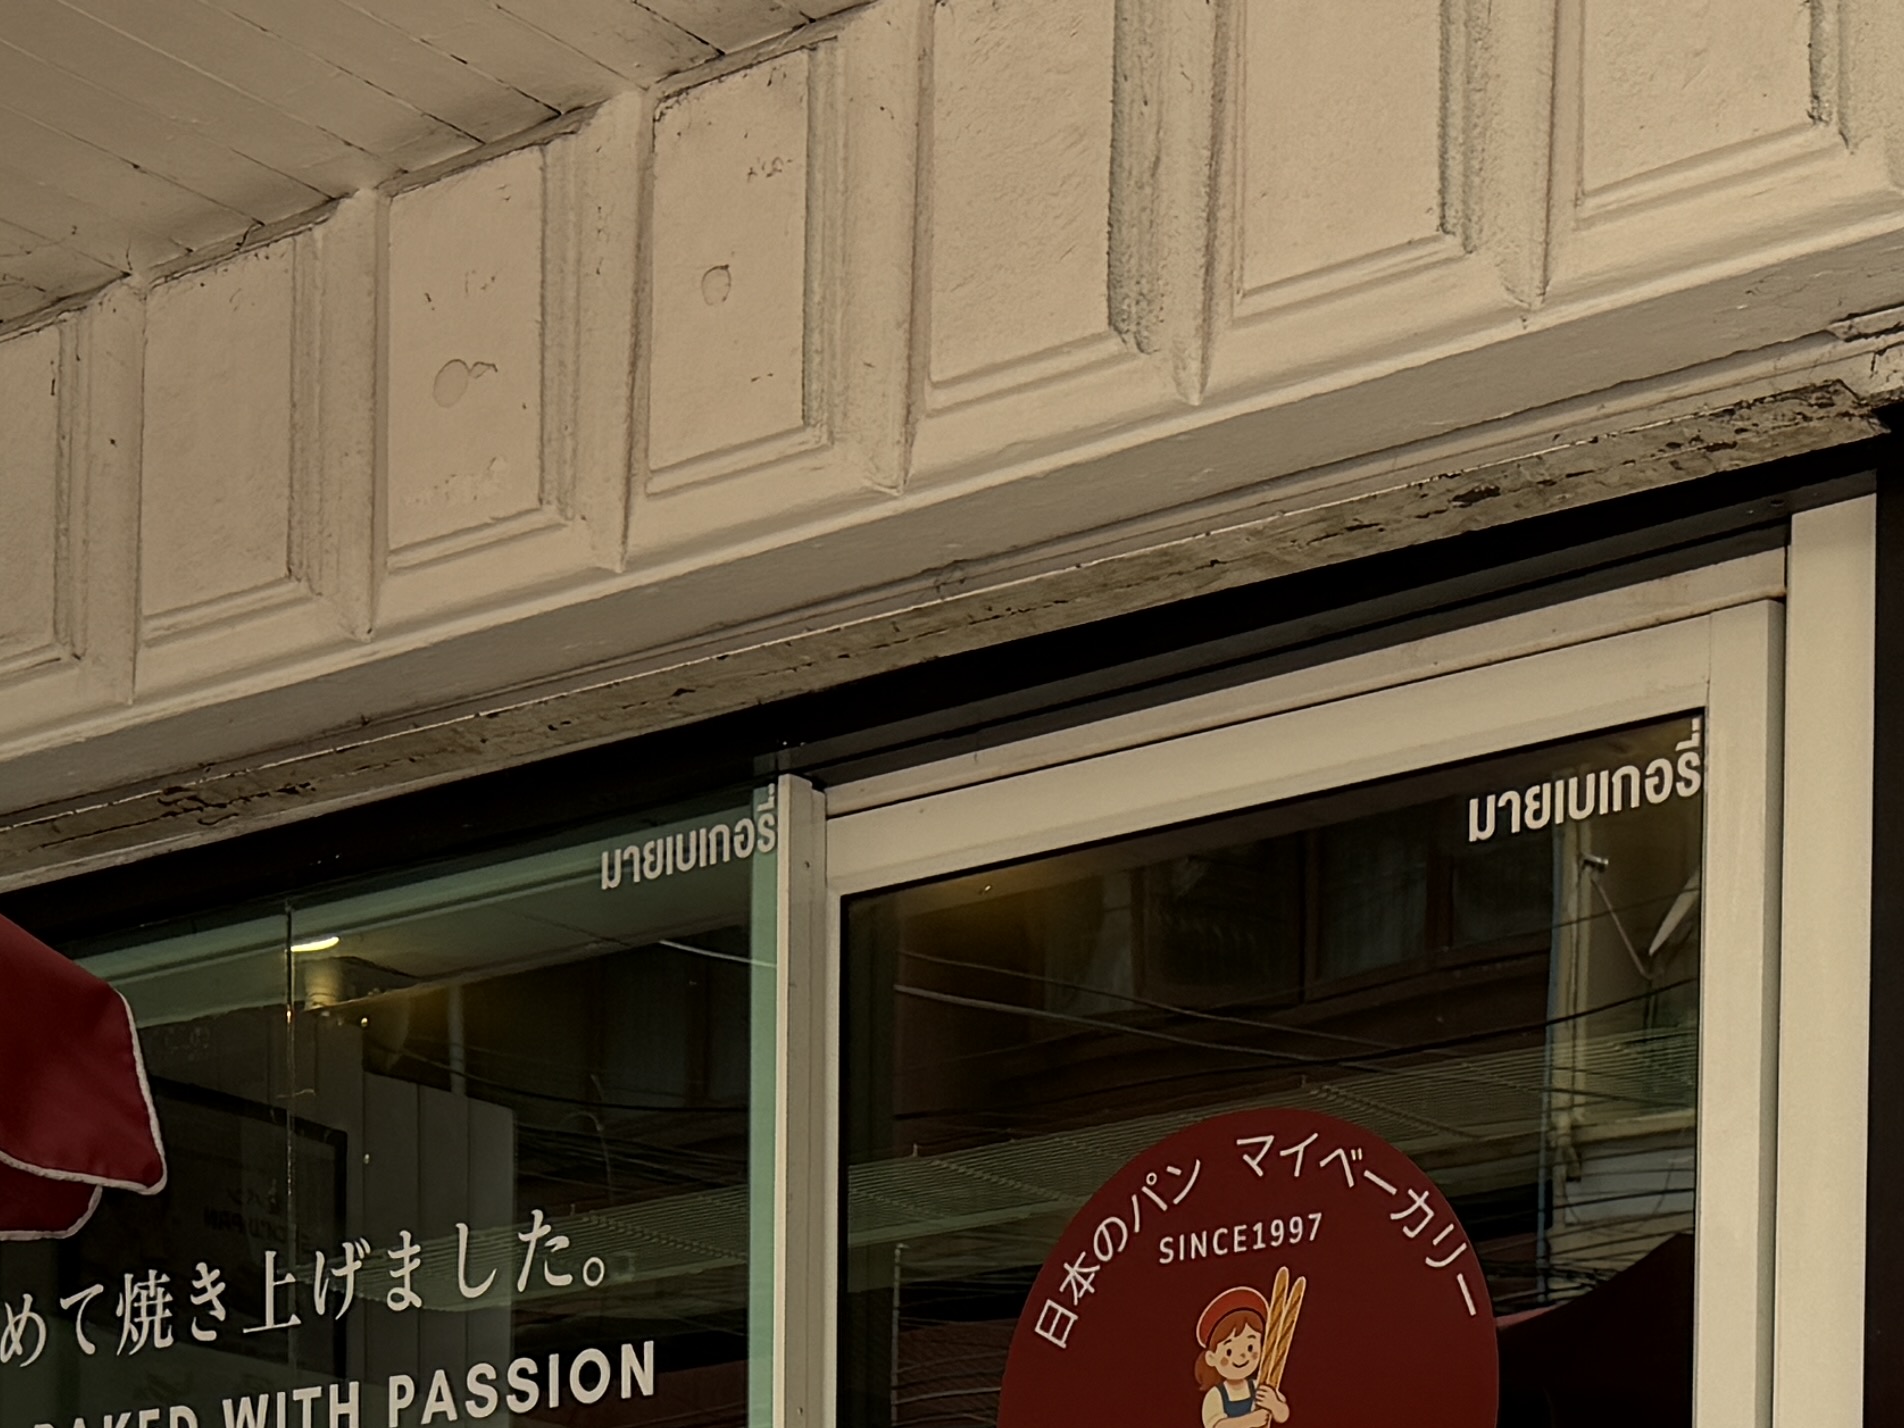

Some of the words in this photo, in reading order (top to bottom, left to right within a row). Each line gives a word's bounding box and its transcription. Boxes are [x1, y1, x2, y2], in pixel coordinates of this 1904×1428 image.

[1469, 717, 1701, 842] มายเบเกอรี่
[601, 783, 776, 890] มายเบเกอรี่
[1035, 1159, 1201, 1349] 日本のパン
[1237, 1132, 1477, 1316] マイベーカリー
[1160, 1212, 1323, 1264] SINCE1997
[388, 1339, 656, 1428] PASSION
